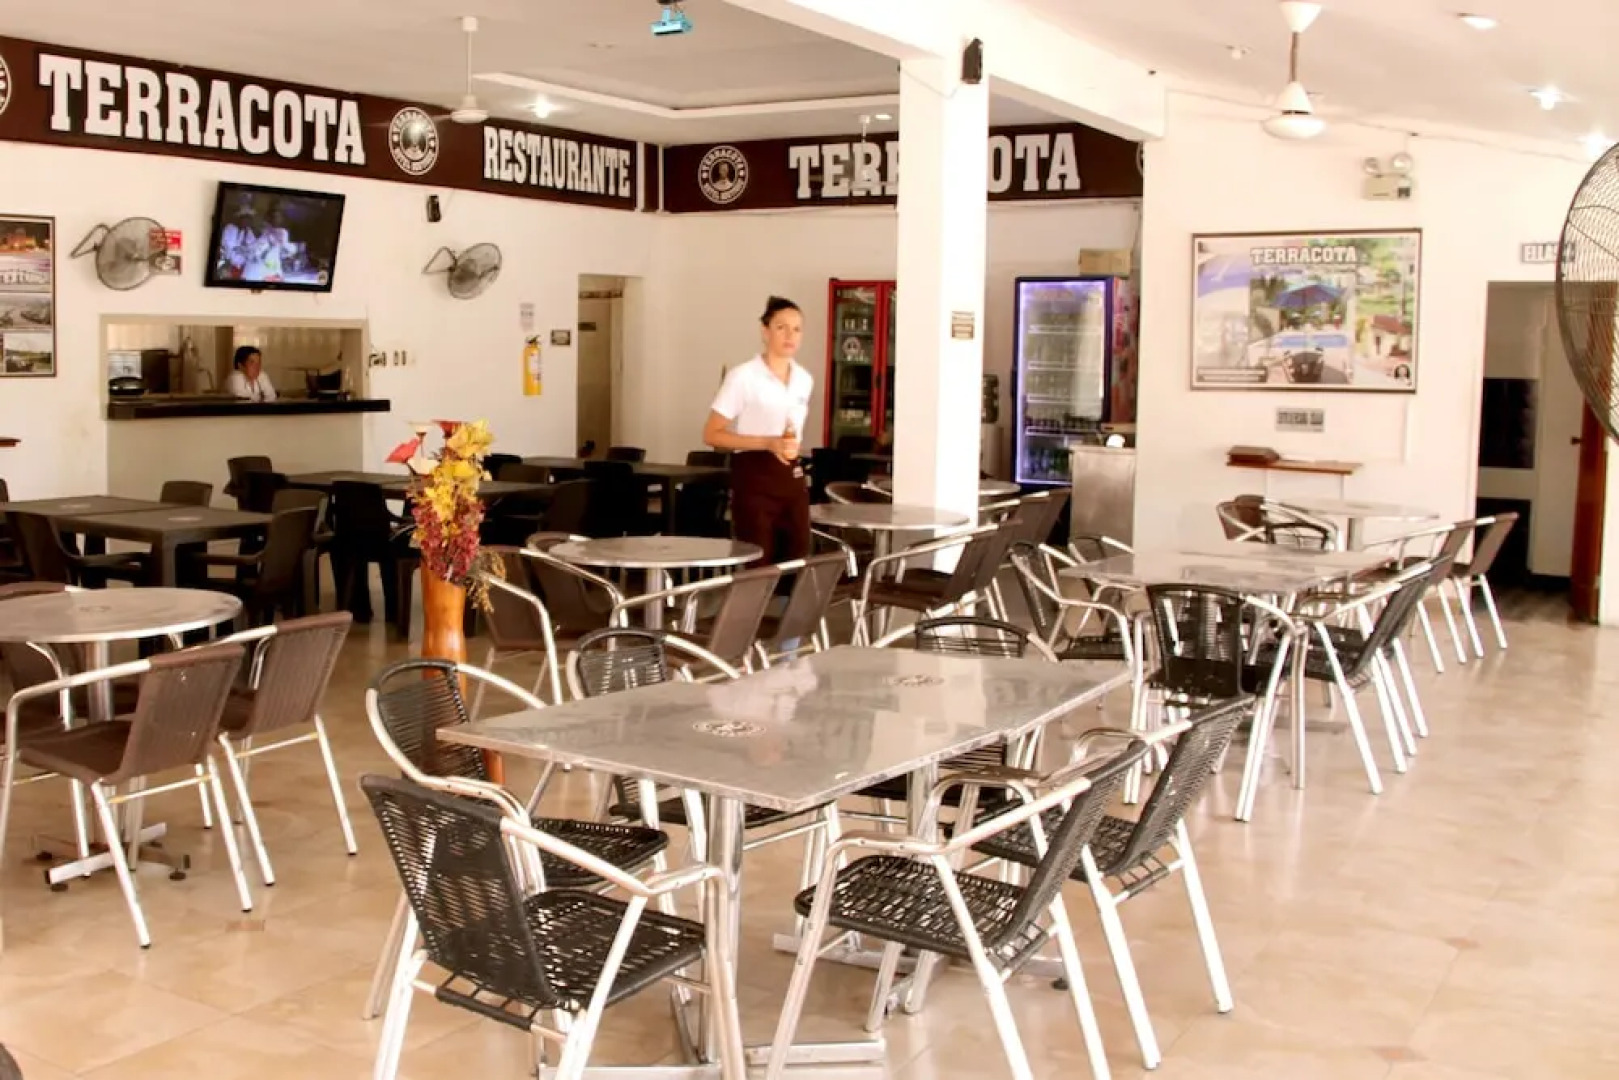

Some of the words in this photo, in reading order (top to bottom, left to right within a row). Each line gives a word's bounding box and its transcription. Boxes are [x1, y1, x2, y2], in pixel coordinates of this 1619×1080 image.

[38, 53, 366, 165] TERRACOTA
[483, 125, 631, 197] RESTAURANTE
[1250, 246, 1357, 264] TERRACOTA
